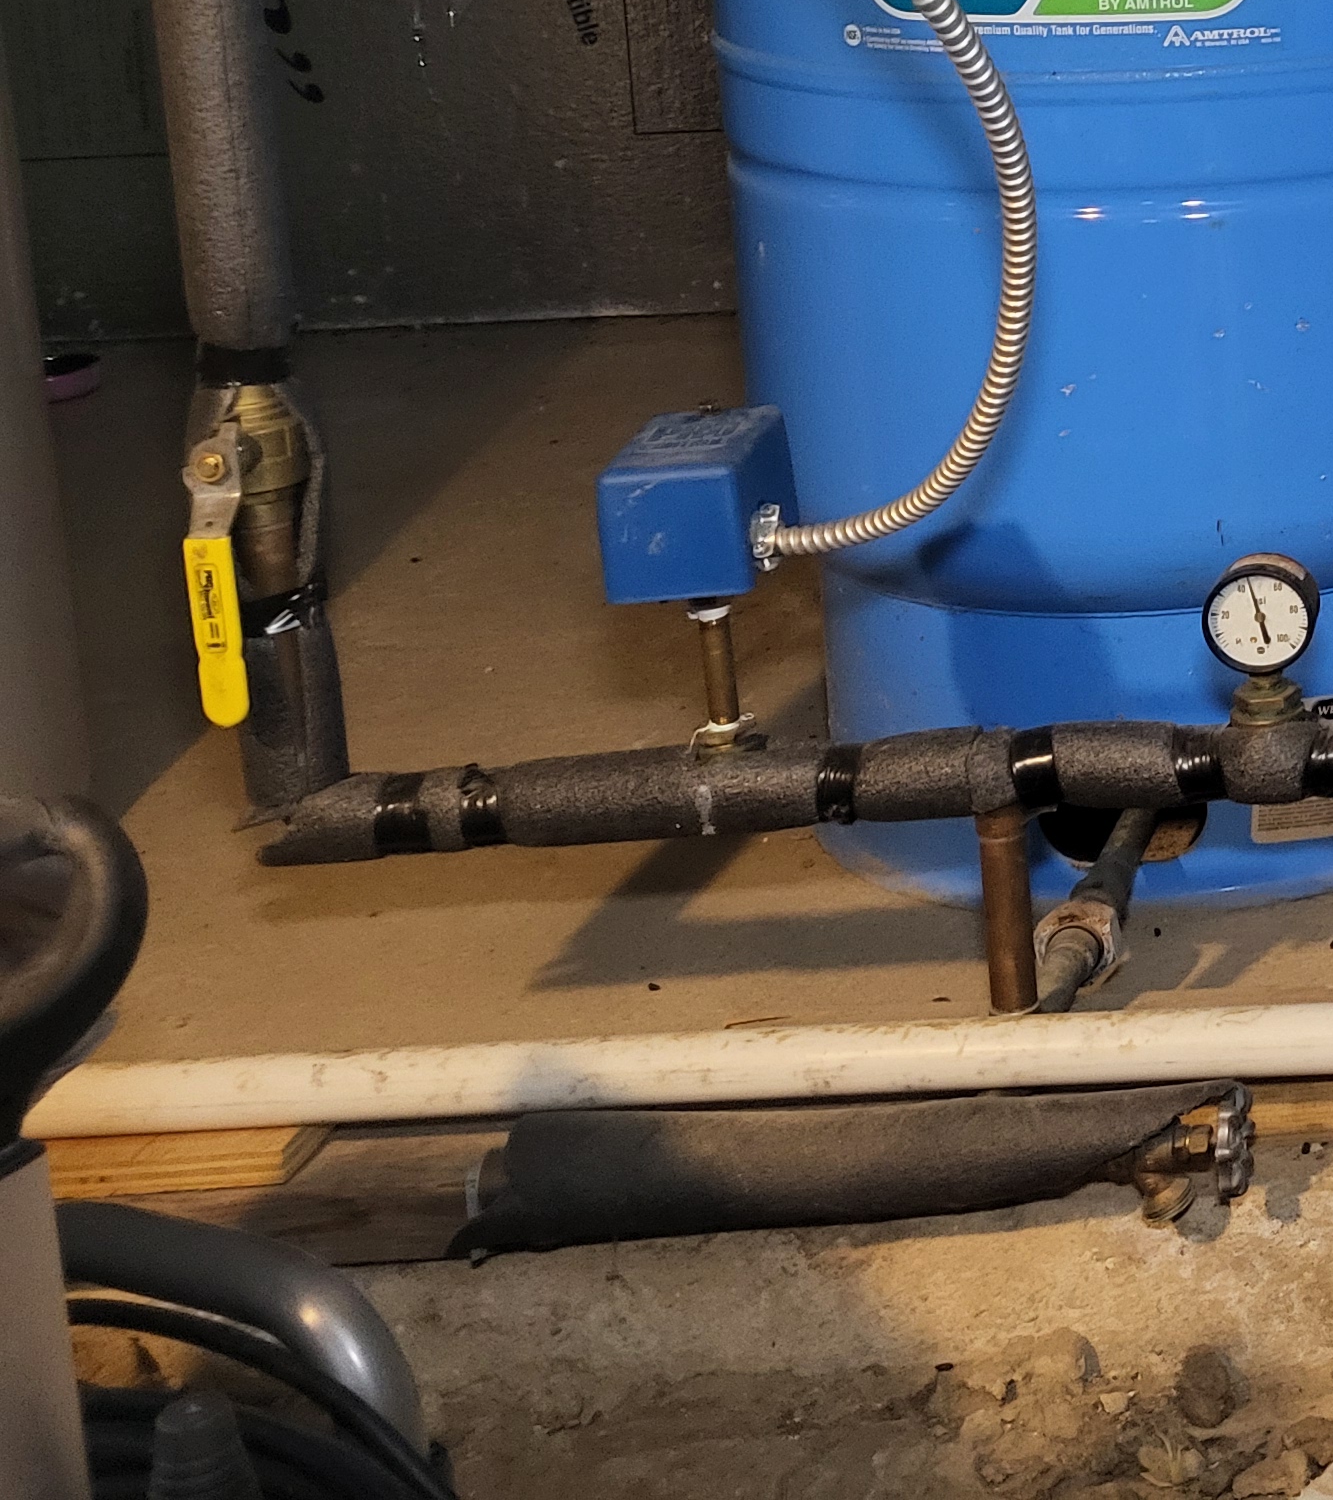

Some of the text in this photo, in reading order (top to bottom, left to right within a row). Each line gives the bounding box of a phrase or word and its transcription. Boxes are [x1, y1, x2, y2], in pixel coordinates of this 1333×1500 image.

[974, 24, 1158, 38] remium Quality Tank for Generations.
[1190, 27, 1271, 40] AMTROL
[1237, 582, 1283, 593] 40 60
[1221, 605, 1298, 619] 20 80
[1277, 634, 1288, 643] 100
